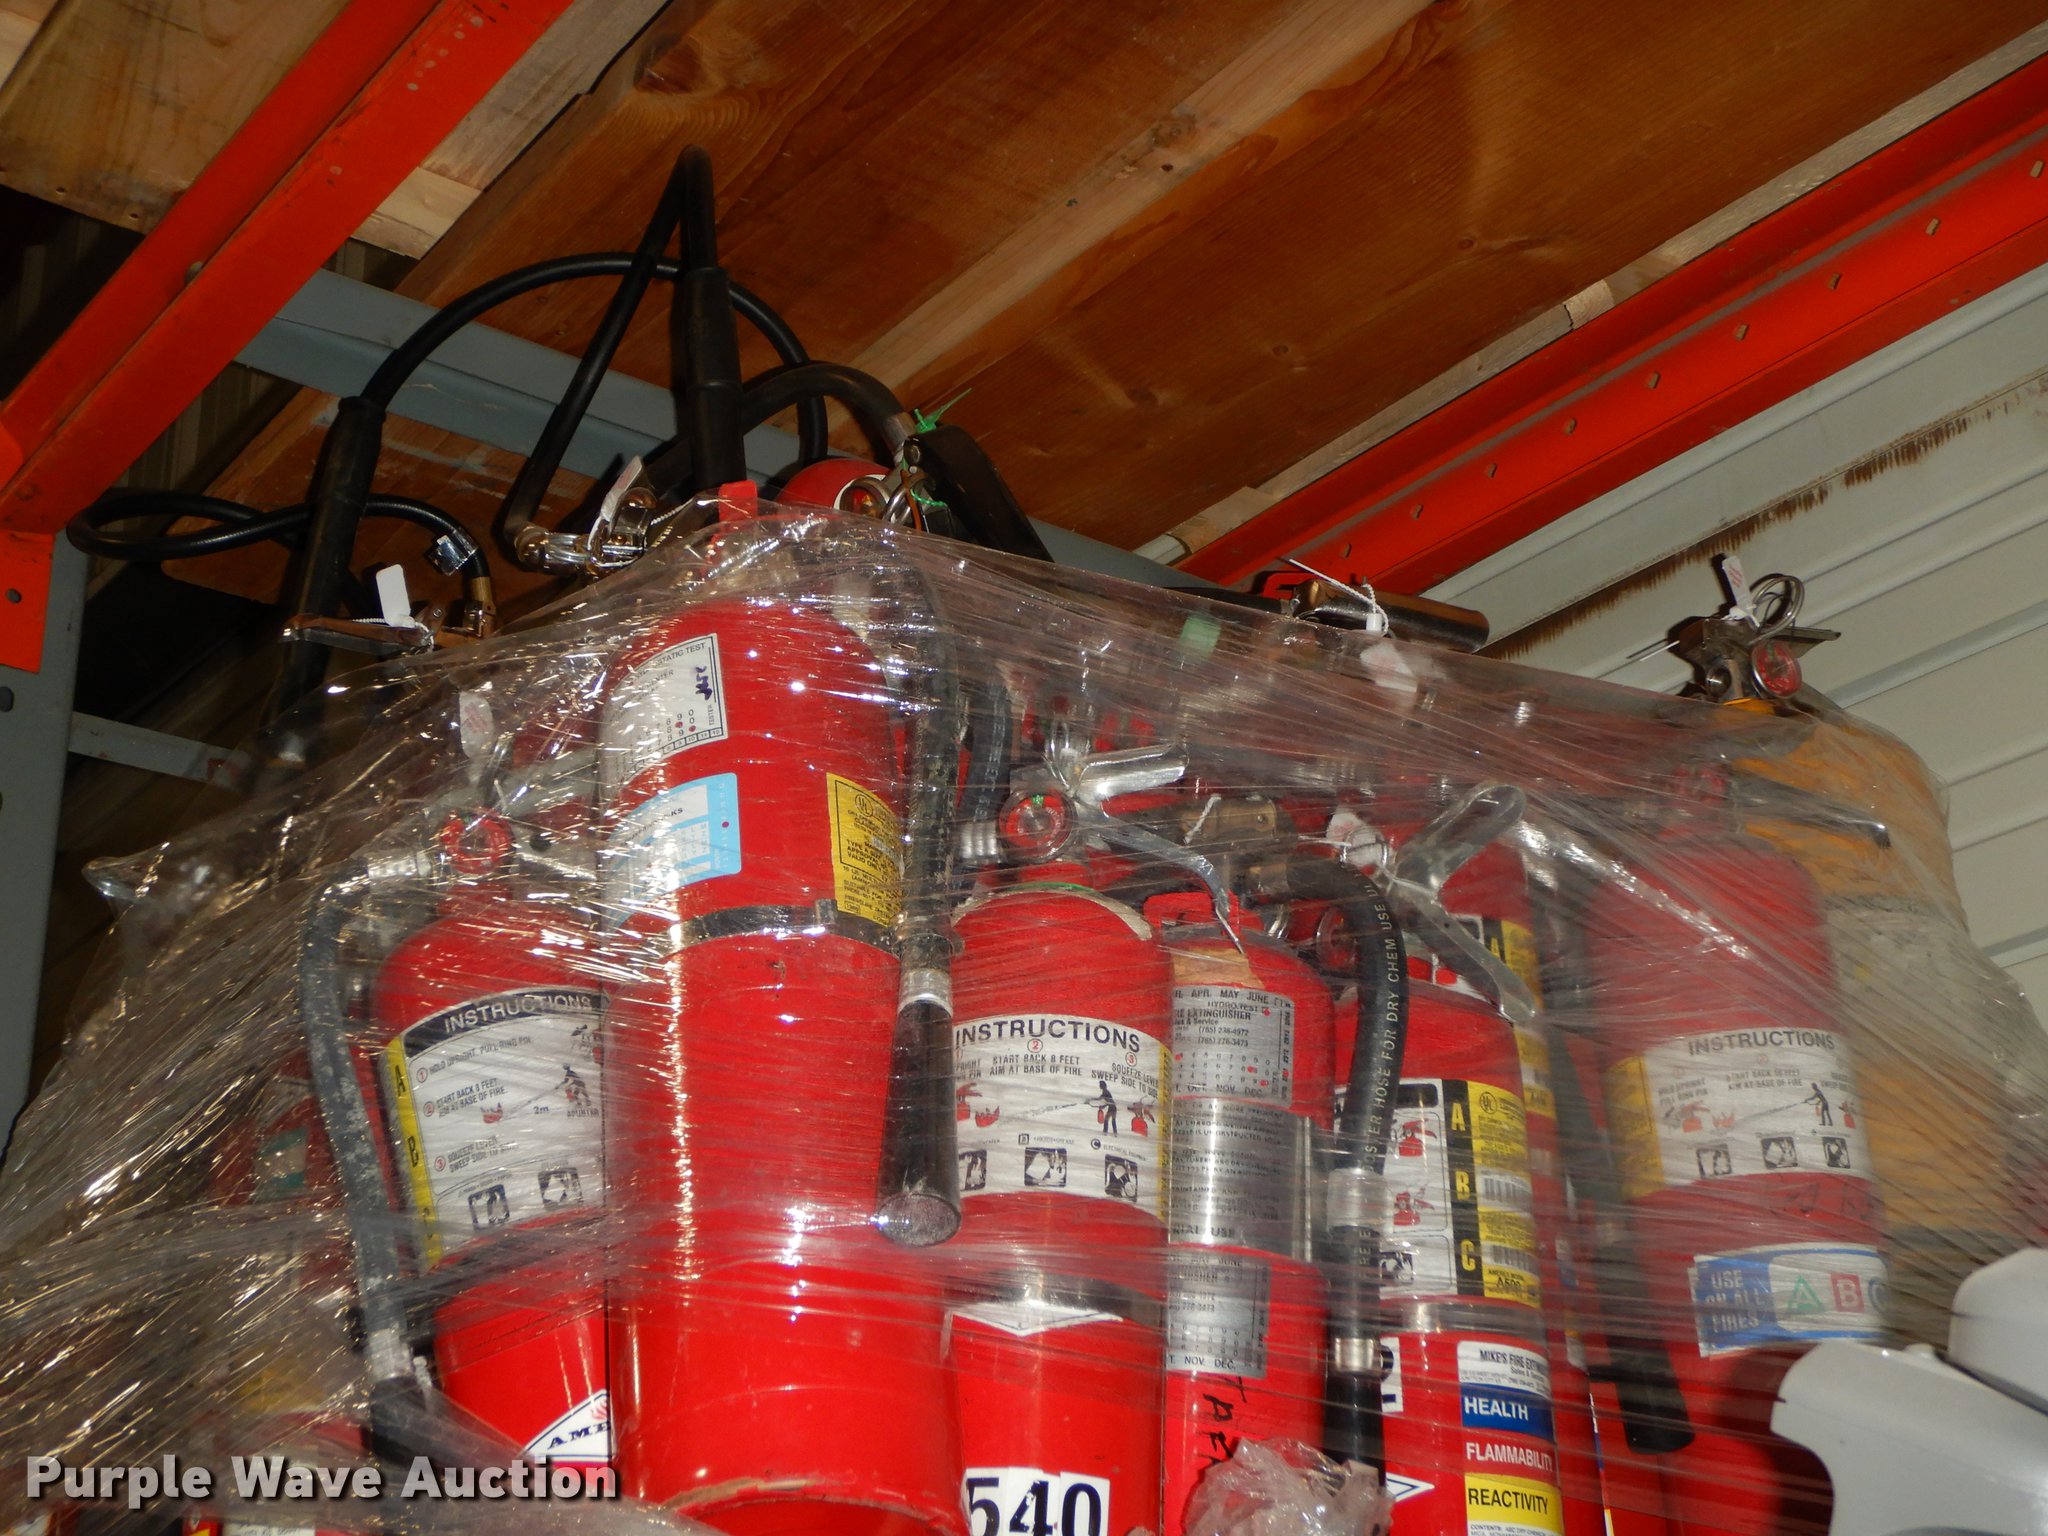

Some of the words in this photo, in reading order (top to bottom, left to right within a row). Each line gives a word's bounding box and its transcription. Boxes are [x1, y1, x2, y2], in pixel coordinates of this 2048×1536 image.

[686, 642, 706, 655] TEST
[1374, 903, 1392, 931] USE
[1386, 937, 1400, 982] CHEM
[1220, 989, 1239, 998] MAY
[1386, 990, 1400, 1022] DRY
[445, 994, 593, 1034] INSTRUCTIONS
[1187, 1008, 1251, 1020] EXTINGUISHER
[956, 1019, 1140, 1053] INSTRUCTIONS
[1380, 1028, 1397, 1061] FOR
[1688, 1031, 1835, 1056] INSTRUCTIONS
[989, 1065, 1005, 1077] AIM
[1023, 1064, 1046, 1074] BASE
[1050, 1065, 1060, 1074] OF
[1064, 1065, 1083, 1077] FIRE
[993, 1054, 1020, 1065] START
[1023, 1053, 1047, 1064] BACK
[1059, 1054, 1080, 1066] FEET
[394, 1065, 406, 1097] A
[456, 1084, 474, 1099] BACK
[1091, 1069, 1119, 1082] SWEEP
[1120, 1076, 1137, 1089] SIDE
[1373, 1068, 1391, 1106] HOSE
[460, 1095, 478, 1109] BASE
[533, 1105, 550, 1115] 2m
[1451, 1102, 1466, 1131] A
[407, 1136, 419, 1168] B
[1455, 1170, 1470, 1200] B
[1460, 1239, 1476, 1271] C
[1712, 1269, 1744, 1290] USE
[1214, 1358, 1236, 1370] DEC.
[1480, 1349, 1508, 1365] MIKE'S
[1464, 1397, 1529, 1421] HEALTH
[548, 1421, 611, 1450] AME
[966, 1477, 1102, 1536] 540
[1468, 1488, 1549, 1514] REACTIVITY
